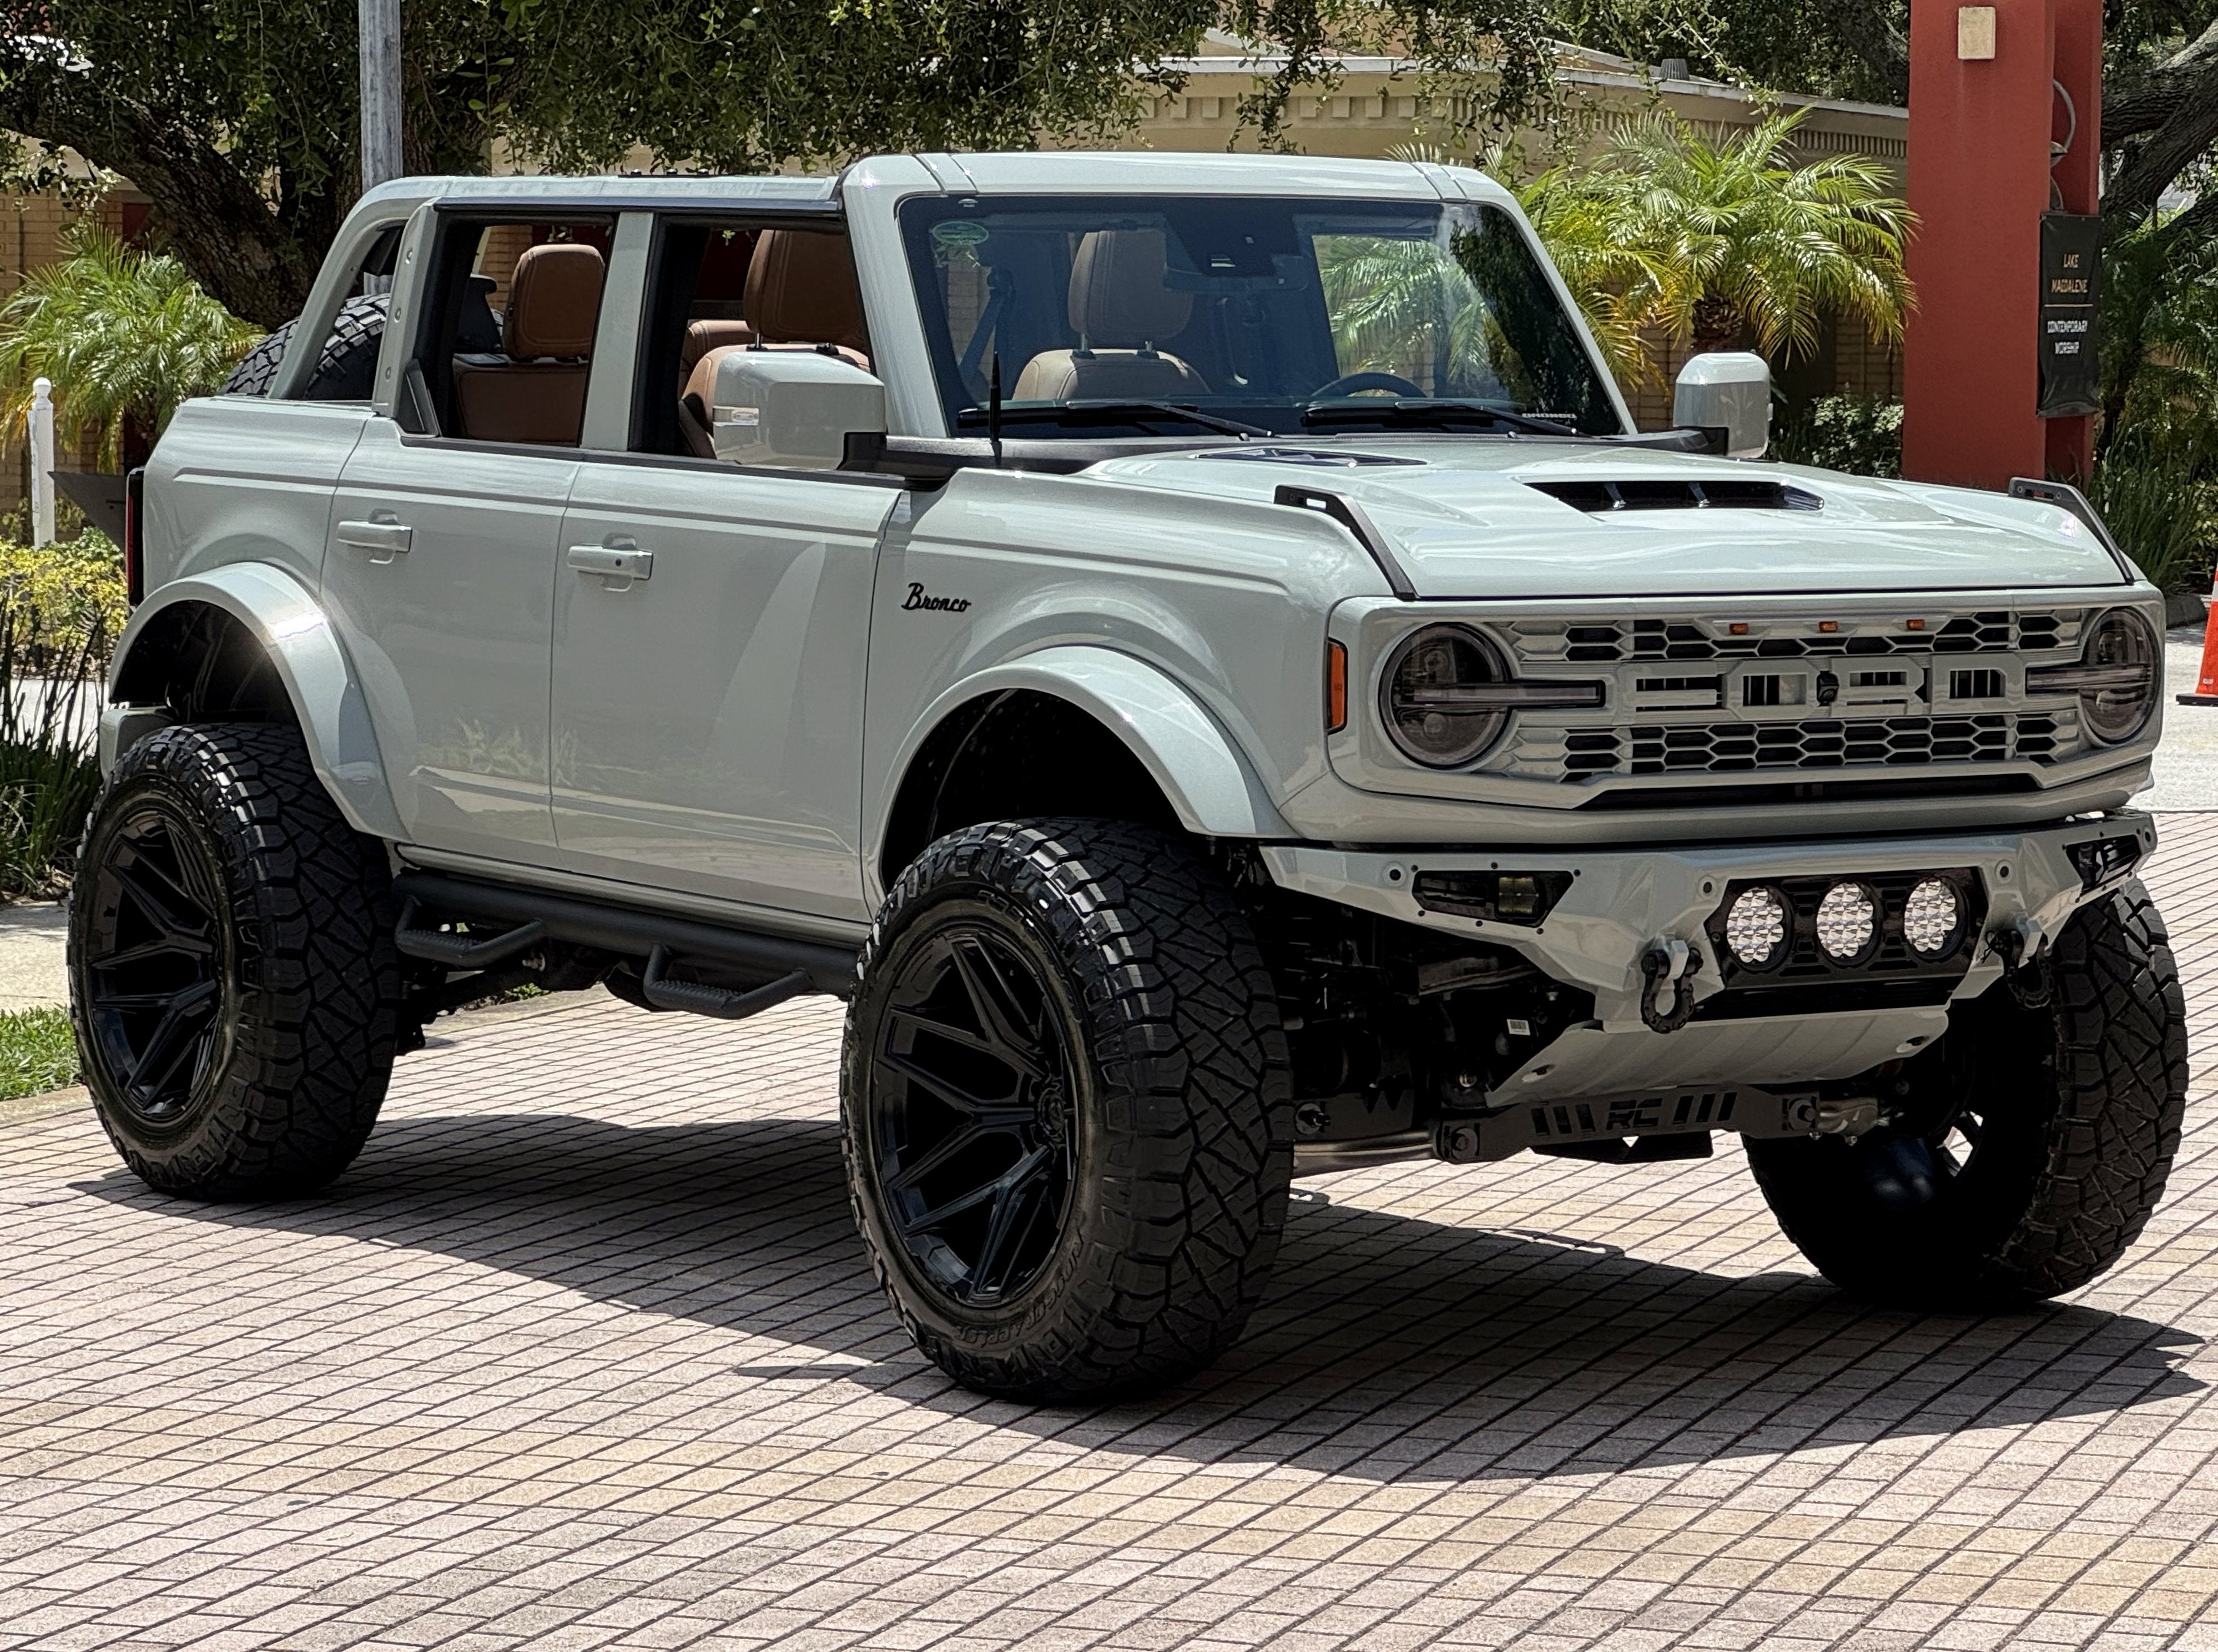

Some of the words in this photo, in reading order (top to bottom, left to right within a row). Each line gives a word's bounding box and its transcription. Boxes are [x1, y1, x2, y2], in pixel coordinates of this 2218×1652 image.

[2063, 254, 2079, 268] LAKE
[2051, 279, 2088, 293] MAGDALENE
[901, 582, 971, 612] Bronco
[1612, 652, 2025, 726] FORD
[1606, 1097, 1663, 1130] RC
